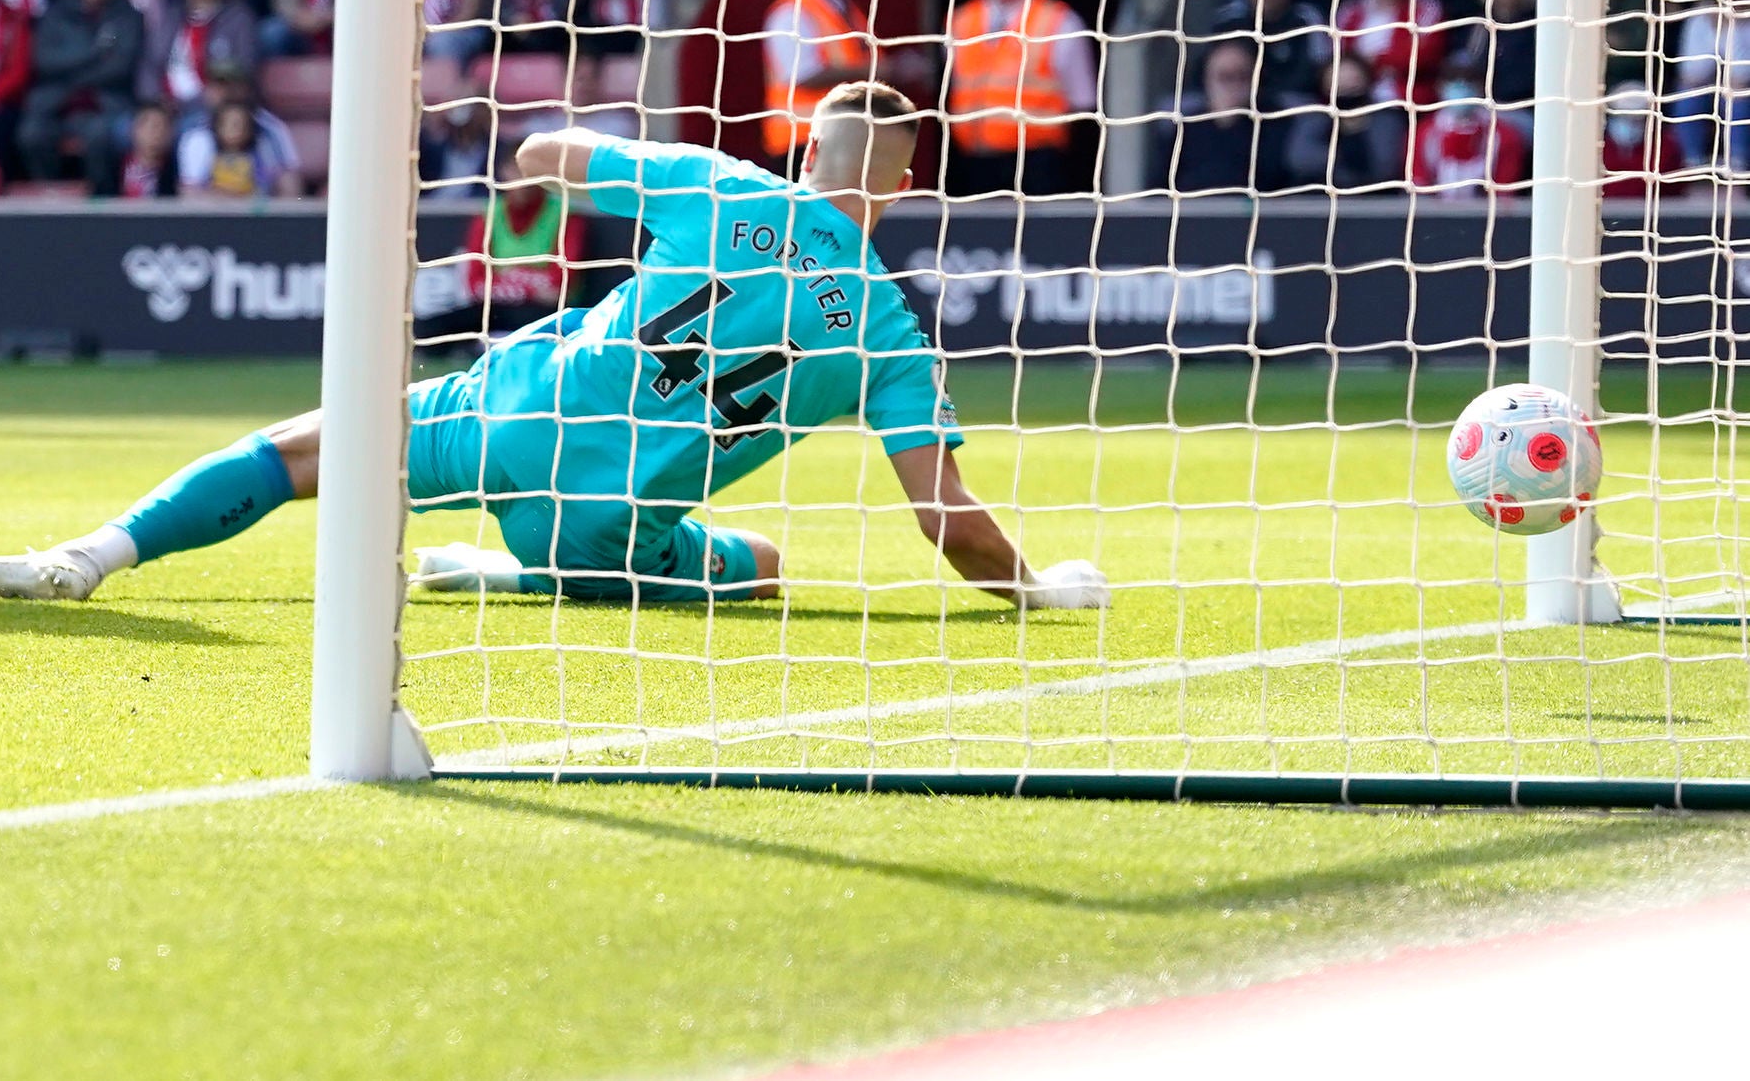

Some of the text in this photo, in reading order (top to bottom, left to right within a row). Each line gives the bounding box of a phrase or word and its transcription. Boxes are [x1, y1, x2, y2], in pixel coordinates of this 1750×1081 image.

[731, 221, 853, 331] FORSTER
[1000, 248, 1274, 323] hummel
[633, 278, 804, 453] 44
